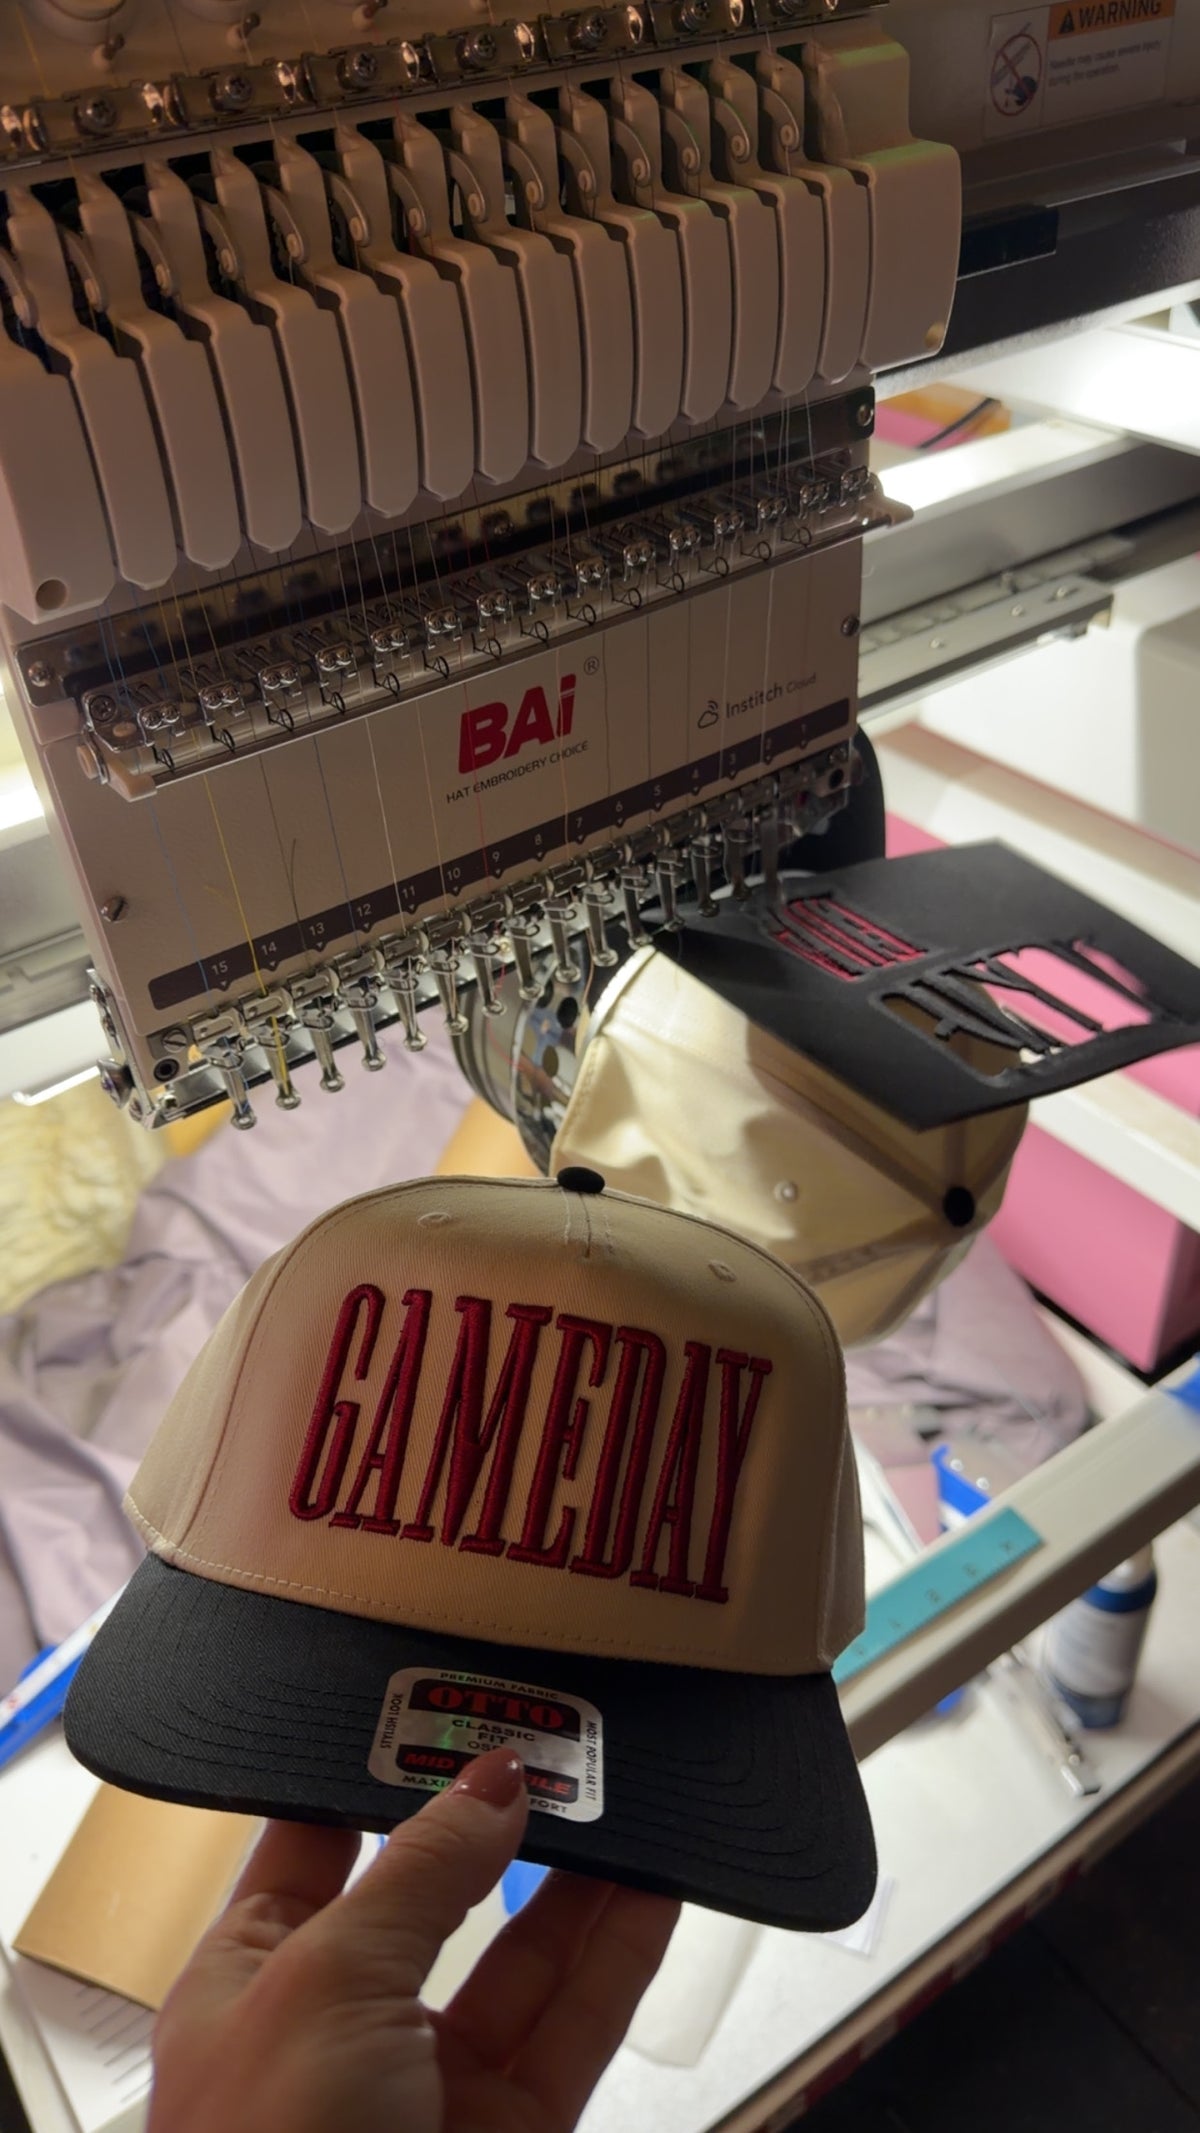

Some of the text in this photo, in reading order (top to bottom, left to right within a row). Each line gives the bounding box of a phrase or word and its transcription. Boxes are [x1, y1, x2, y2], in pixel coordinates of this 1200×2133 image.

[1080, 0, 1162, 28] WARNING
[725, 682, 783, 718] Institch
[446, 740, 590, 804] HAT EMBROIDERY CHOICE
[211, 960, 229, 976] 15
[261, 941, 277, 957] 14
[309, 922, 325, 937] 13
[357, 903, 373, 918] 12
[402, 885, 416, 899] 11
[447, 867, 461, 881] 10
[492, 851, 500, 863] 9
[534, 834, 543, 846] 8
[576, 817, 583, 829] 7
[615, 801, 623, 813] 6
[653, 786, 662, 797] 5
[289, 1283, 773, 1604] GAMEDAY
[440, 1672, 559, 1700] PREMIUM FABRIC
[380, 1694, 403, 1749] STYLISH LOOK
[428, 1686, 564, 1729] OTTO
[452, 1719, 537, 1742] CLASSIC
[477, 1732, 508, 1745] FIT
[404, 1753, 455, 1769] MID
[585, 1721, 598, 1801] MOST POPULAR FIT
